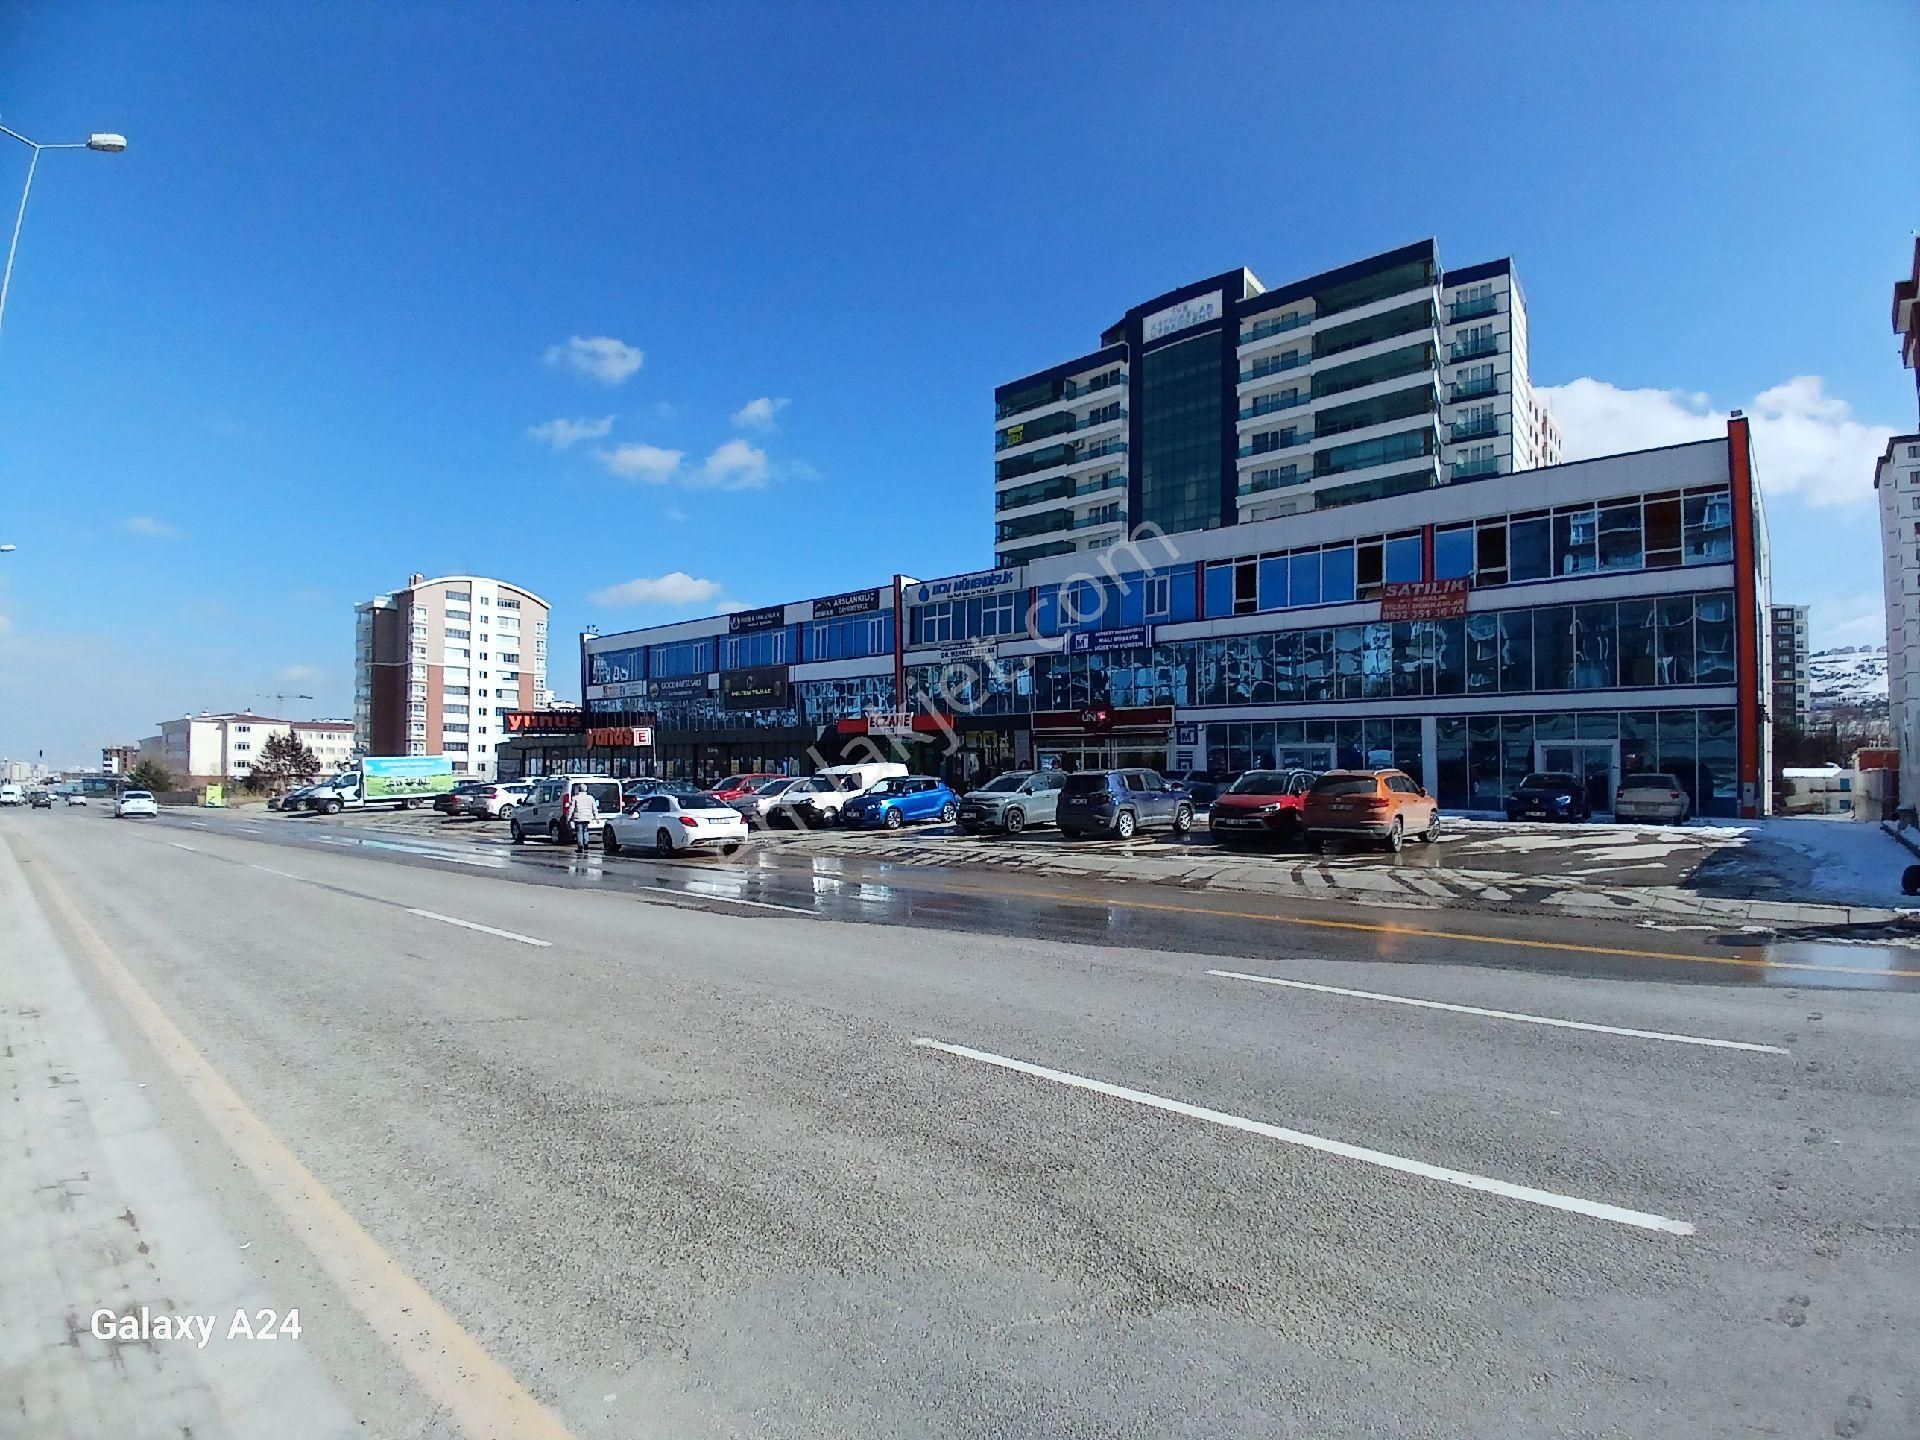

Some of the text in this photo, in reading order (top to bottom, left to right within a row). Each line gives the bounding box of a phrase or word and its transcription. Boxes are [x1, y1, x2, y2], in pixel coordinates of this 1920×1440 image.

[1385, 580, 1466, 597] SATILIK
[507, 715, 582, 731] yunus
[869, 714, 910, 728] ECZANE
[586, 726, 634, 750] yunus
